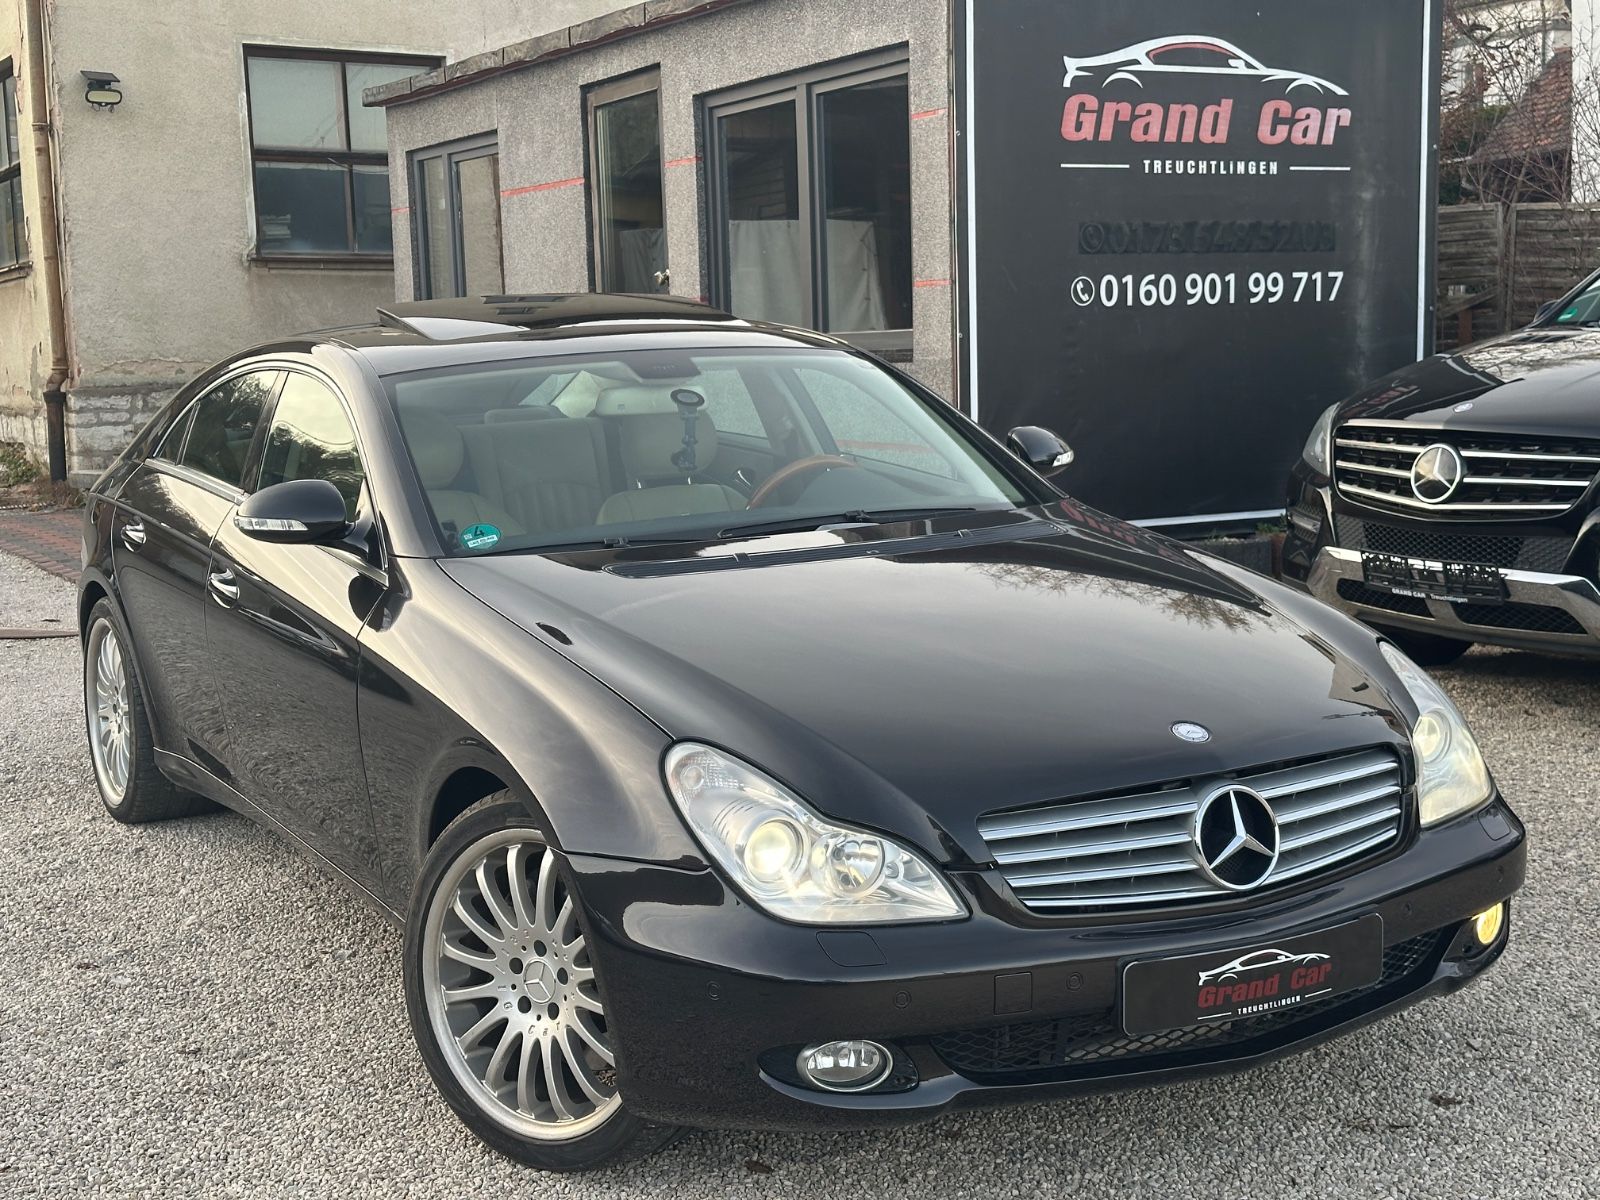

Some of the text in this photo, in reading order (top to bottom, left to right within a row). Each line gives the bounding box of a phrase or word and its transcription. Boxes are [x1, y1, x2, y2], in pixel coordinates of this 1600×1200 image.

[1060, 93, 1352, 145] Grand Car
[1099, 271, 1344, 307] 0160 901 99 717
[474, 526, 485, 536] 4
[1391, 588, 1412, 597] GRAND
[1198, 962, 1333, 1008] Grand Car
[1238, 995, 1301, 1014] TREUCHTLINGEN
